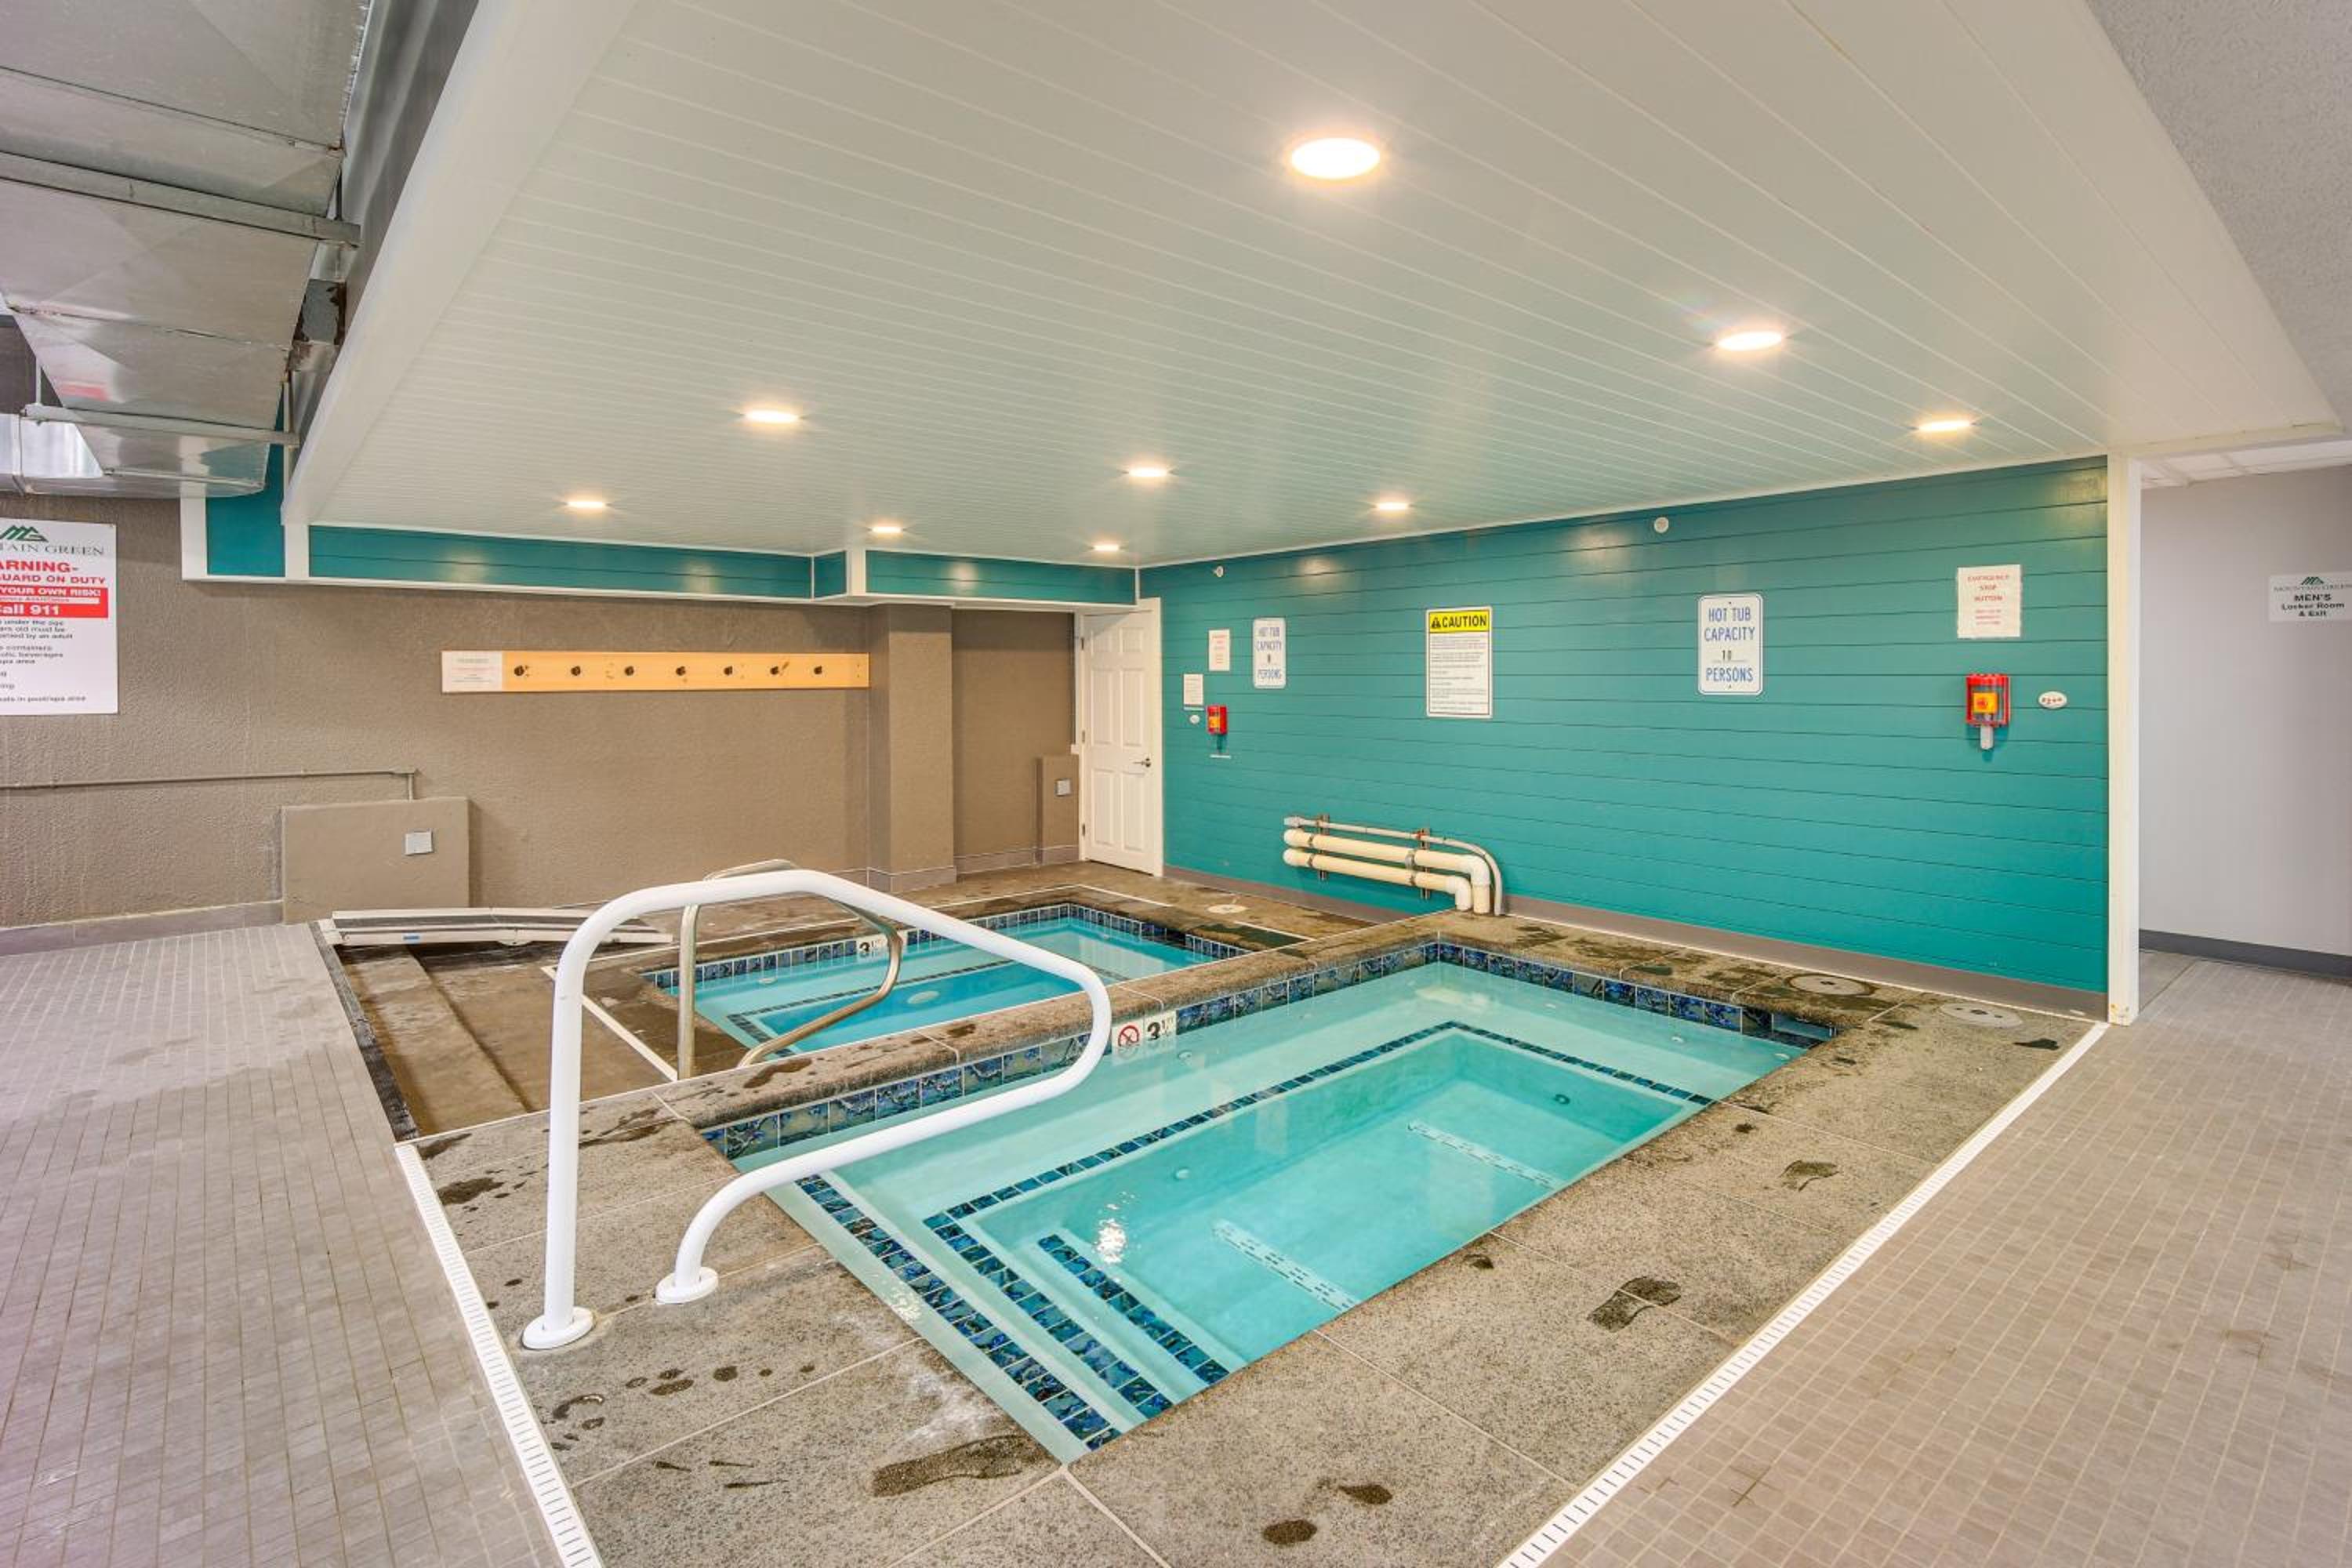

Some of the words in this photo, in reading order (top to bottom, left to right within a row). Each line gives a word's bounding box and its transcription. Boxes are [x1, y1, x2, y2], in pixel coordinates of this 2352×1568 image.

[30, 605, 59, 615] 911
[1708, 608, 1727, 622] HOT
[1732, 607, 1751, 622] TUB
[1442, 615, 1487, 628] CAUTION
[1704, 626, 1755, 642] CAPACITY
[1705, 667, 1754, 682] PERSONS
